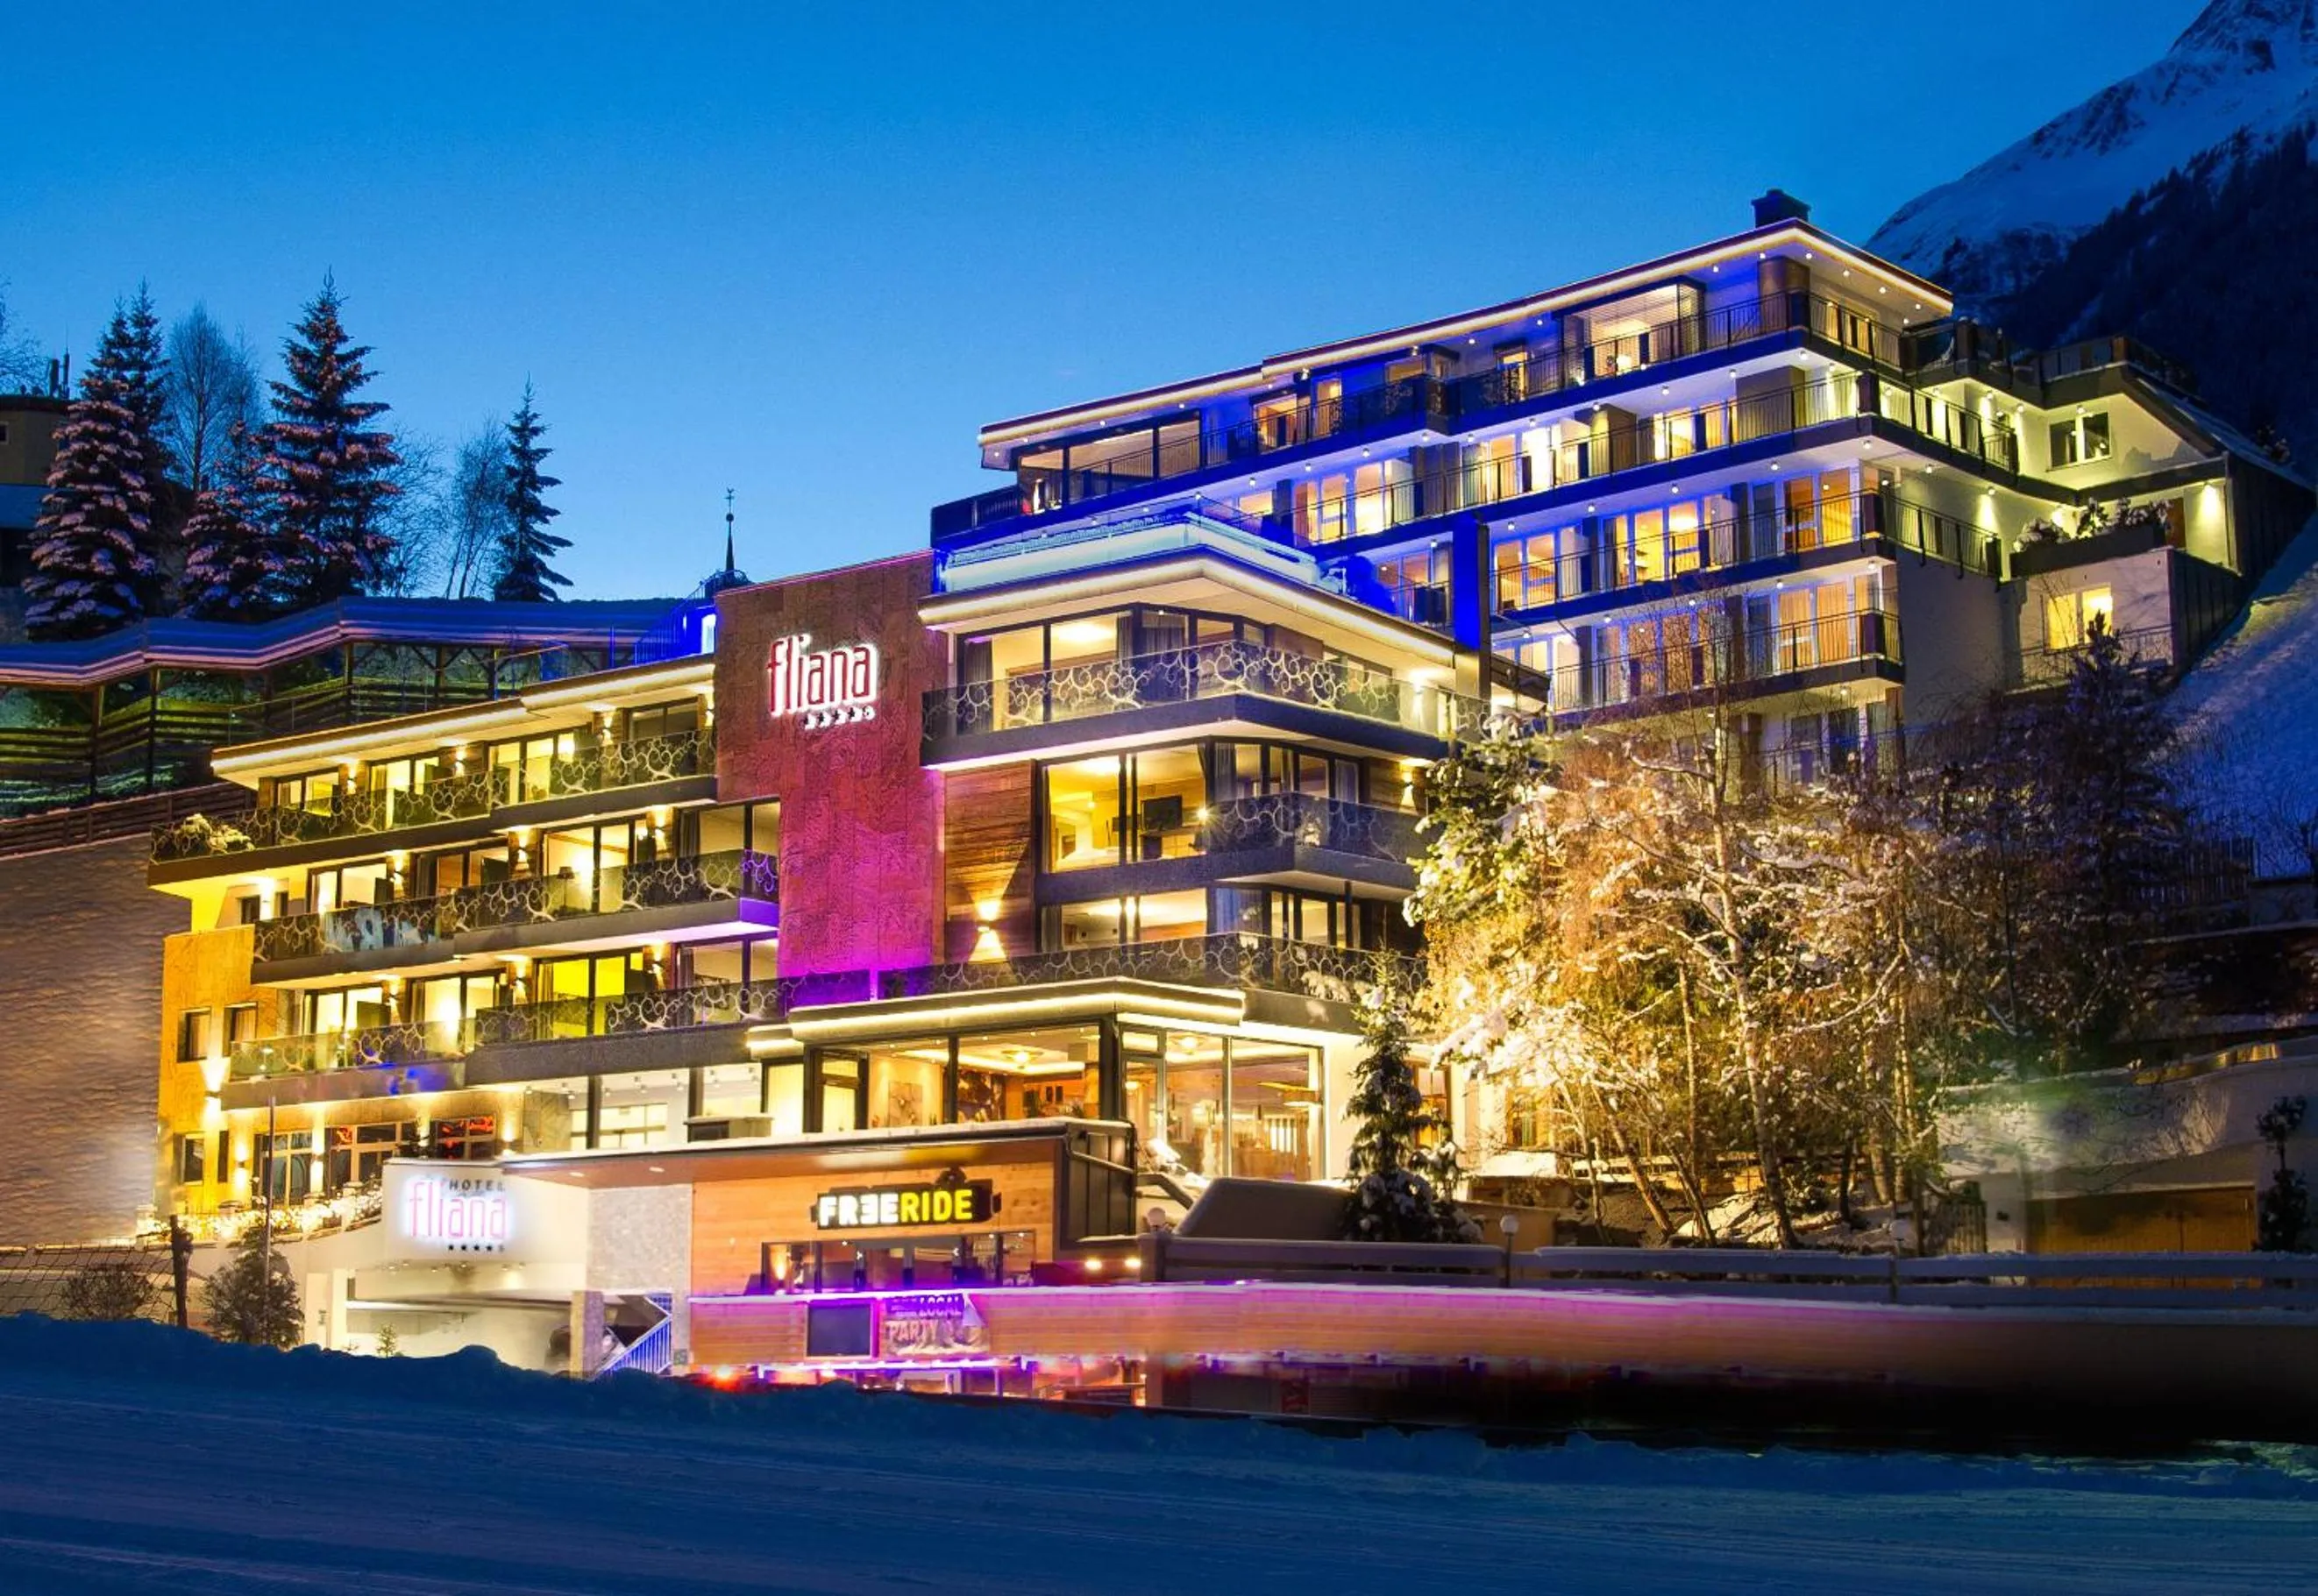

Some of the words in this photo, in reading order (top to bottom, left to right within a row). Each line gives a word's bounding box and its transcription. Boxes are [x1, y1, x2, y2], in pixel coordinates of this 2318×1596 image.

[765, 635, 877, 713] fliana
[449, 1179, 506, 1191] HOTEL
[819, 1189, 972, 1226] FREERIDE
[409, 1181, 506, 1239] fliana
